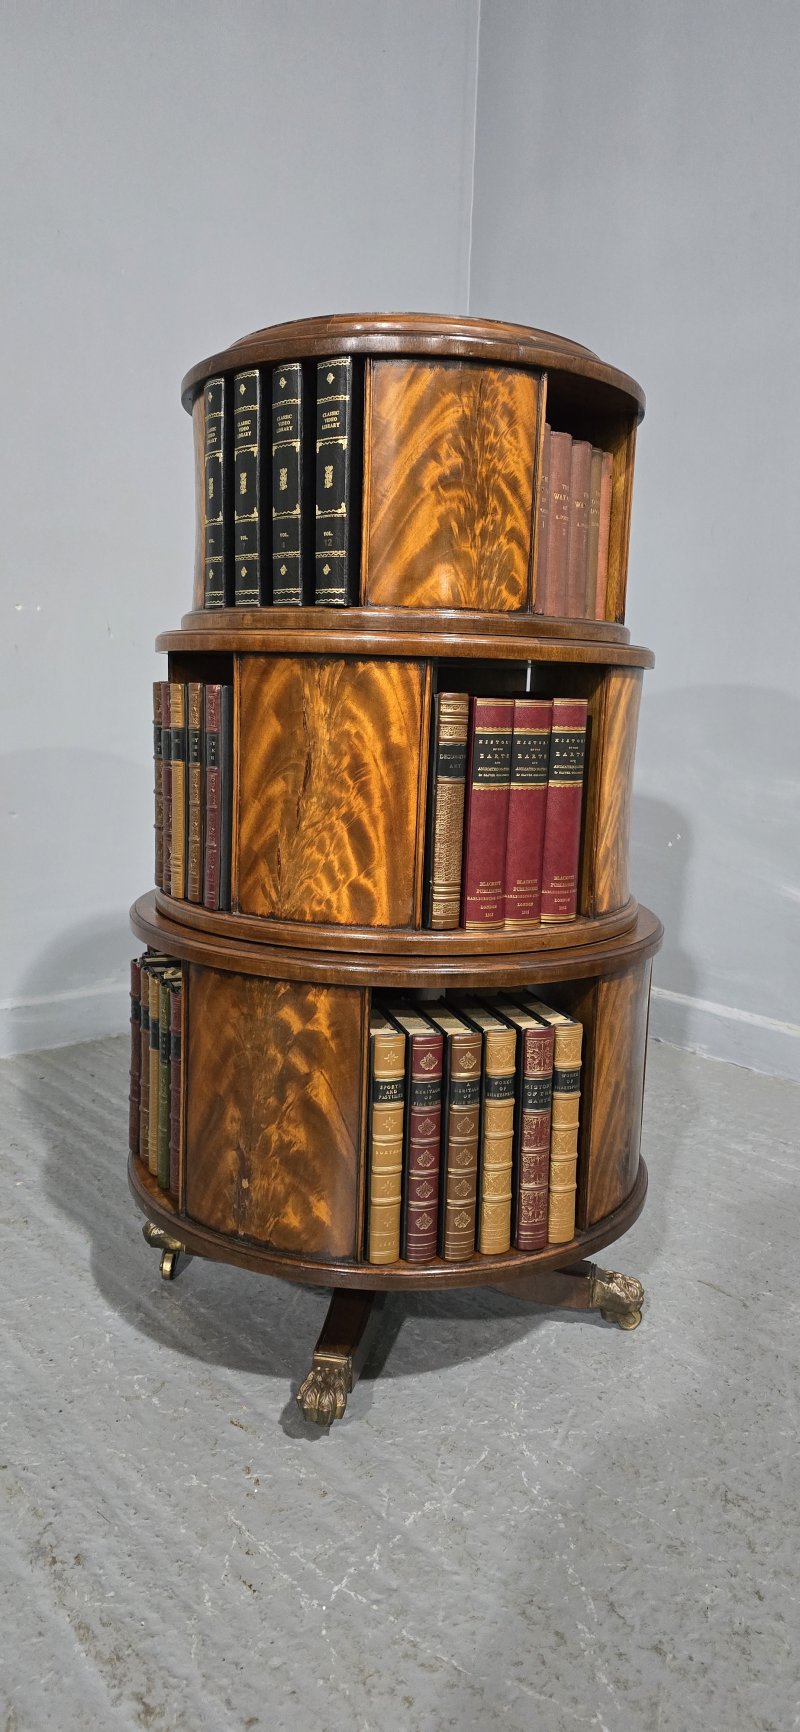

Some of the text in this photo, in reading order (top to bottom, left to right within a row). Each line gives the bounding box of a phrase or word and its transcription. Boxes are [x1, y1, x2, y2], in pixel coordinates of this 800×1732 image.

[276, 413, 293, 422] CLASSIC
[322, 410, 340, 418] CLASSIC
[276, 425, 293, 433] LIBRARY
[321, 422, 340, 430] LIBRARY
[324, 538, 333, 547] 12
